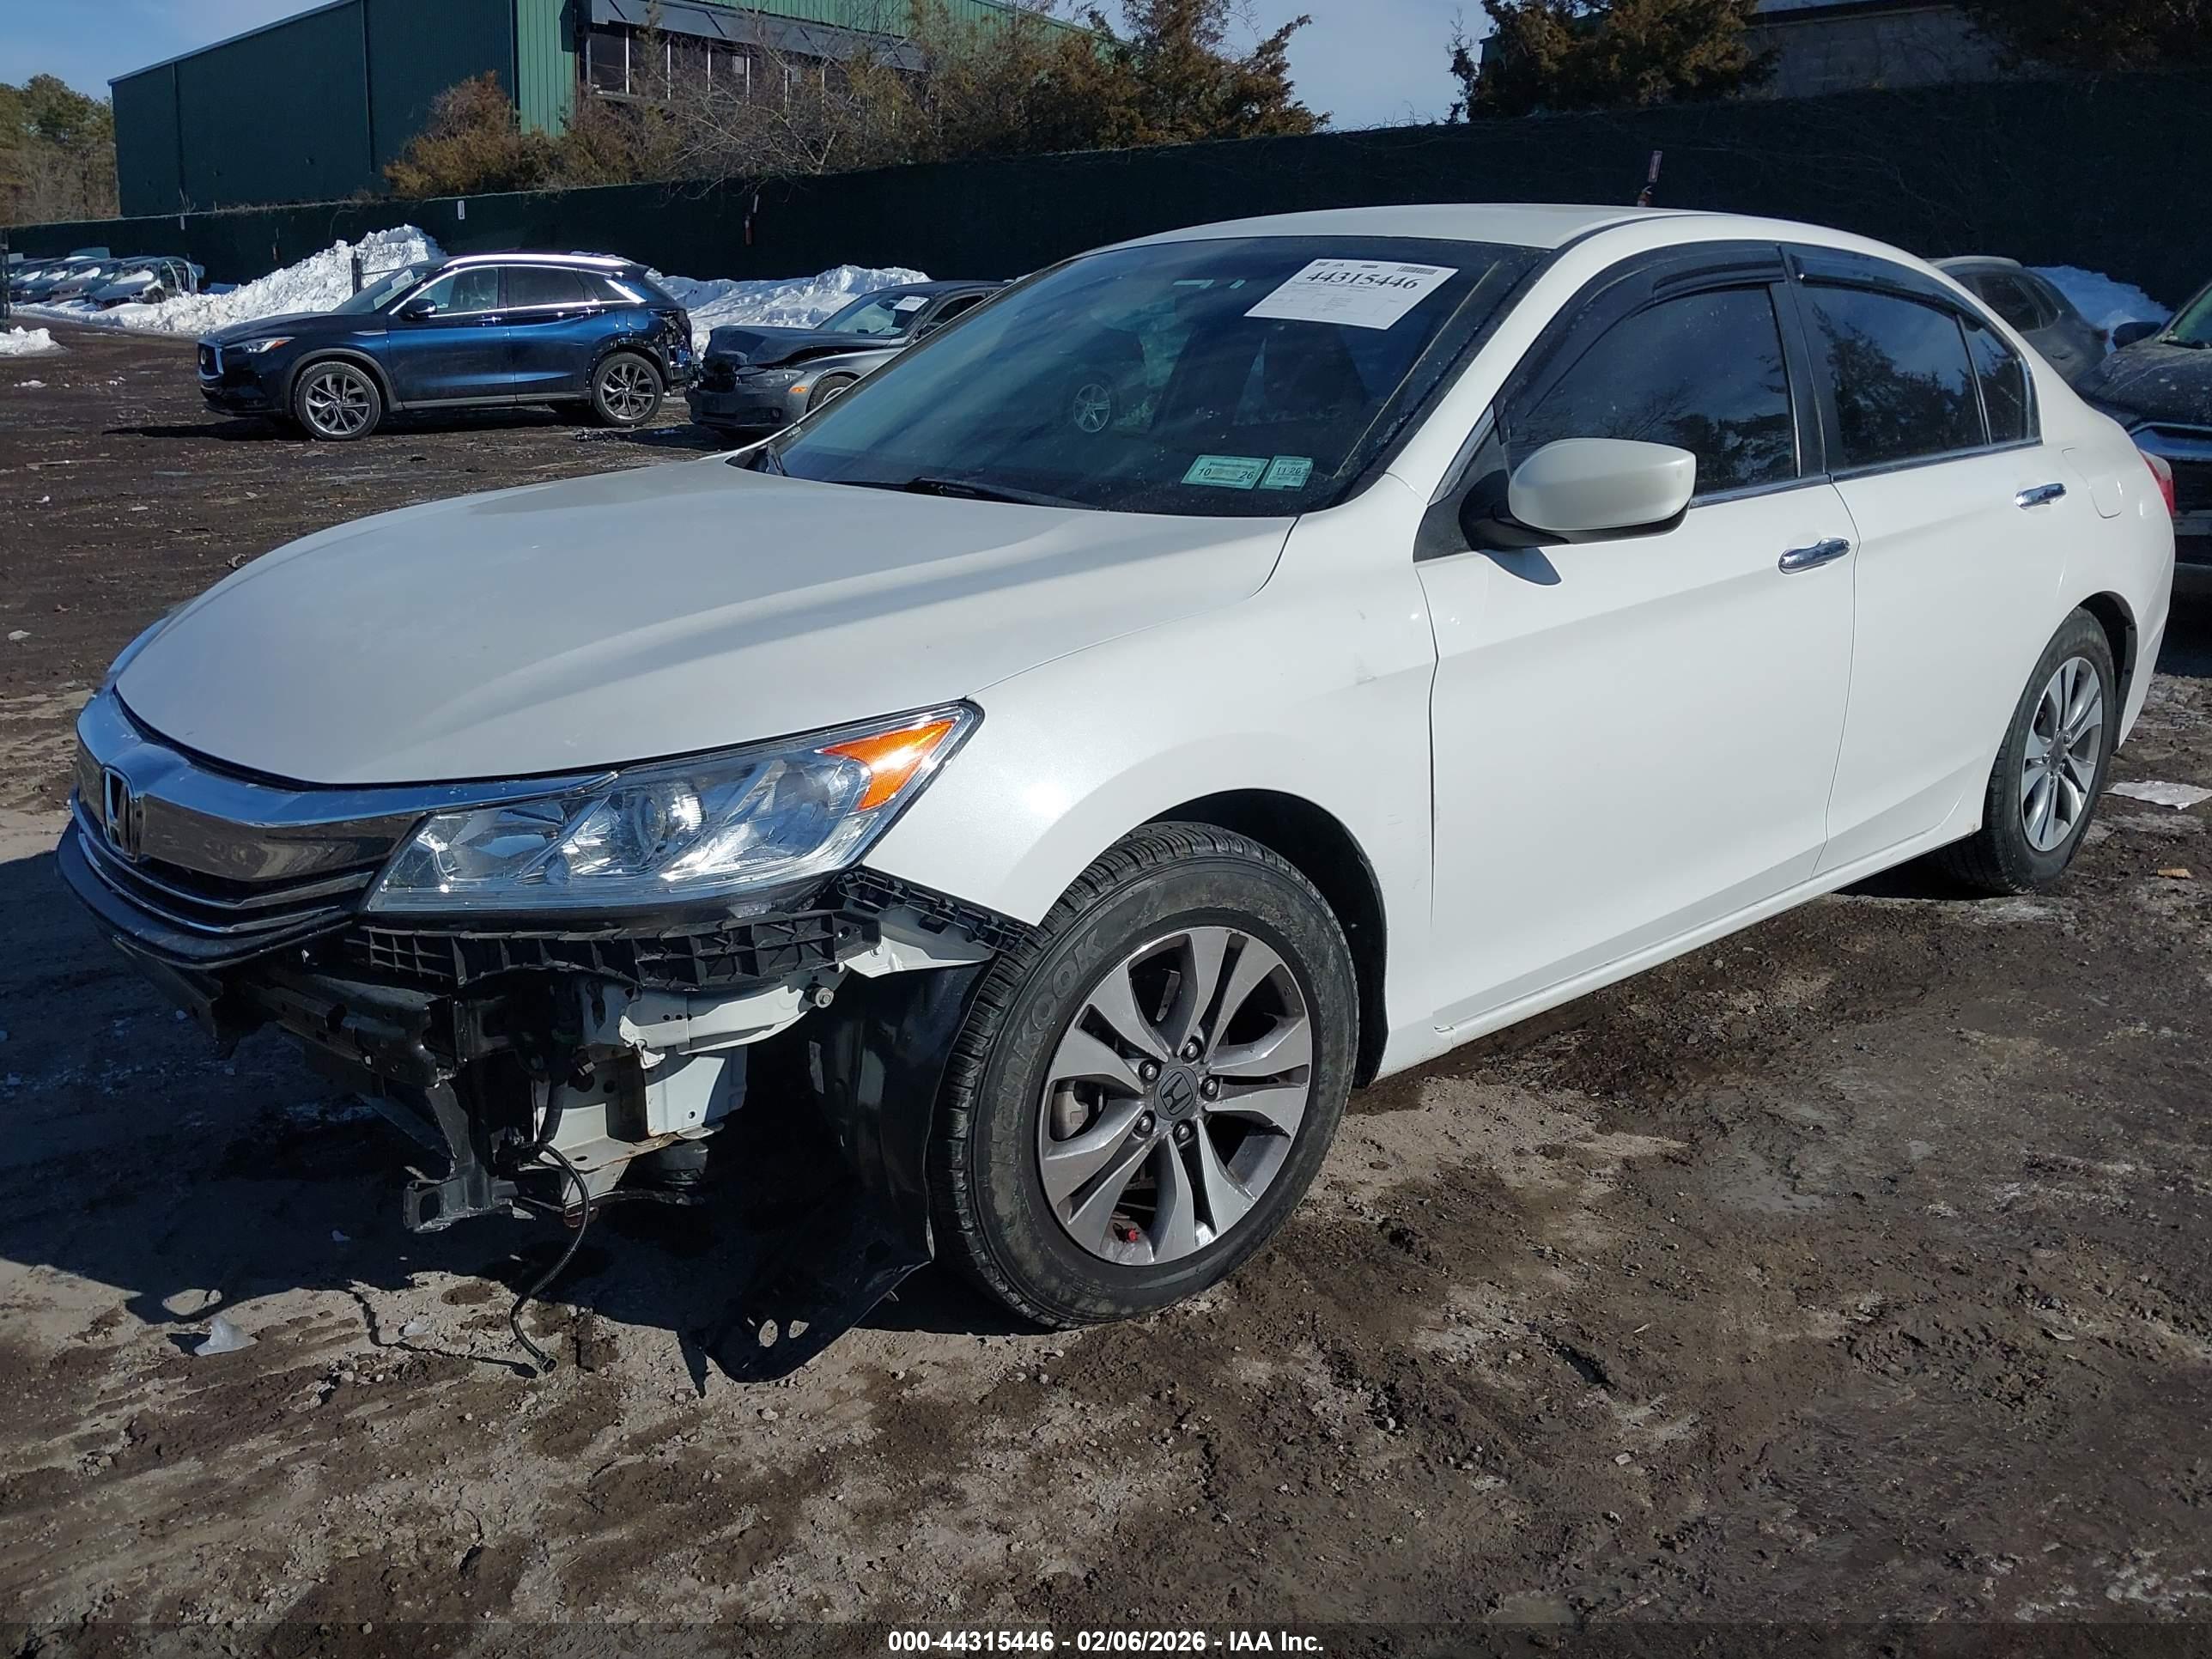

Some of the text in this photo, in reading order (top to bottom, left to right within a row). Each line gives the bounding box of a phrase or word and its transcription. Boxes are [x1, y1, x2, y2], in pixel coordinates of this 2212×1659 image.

[1305, 270, 1423, 290] 44315446
[1198, 468, 1255, 479] 10 26
